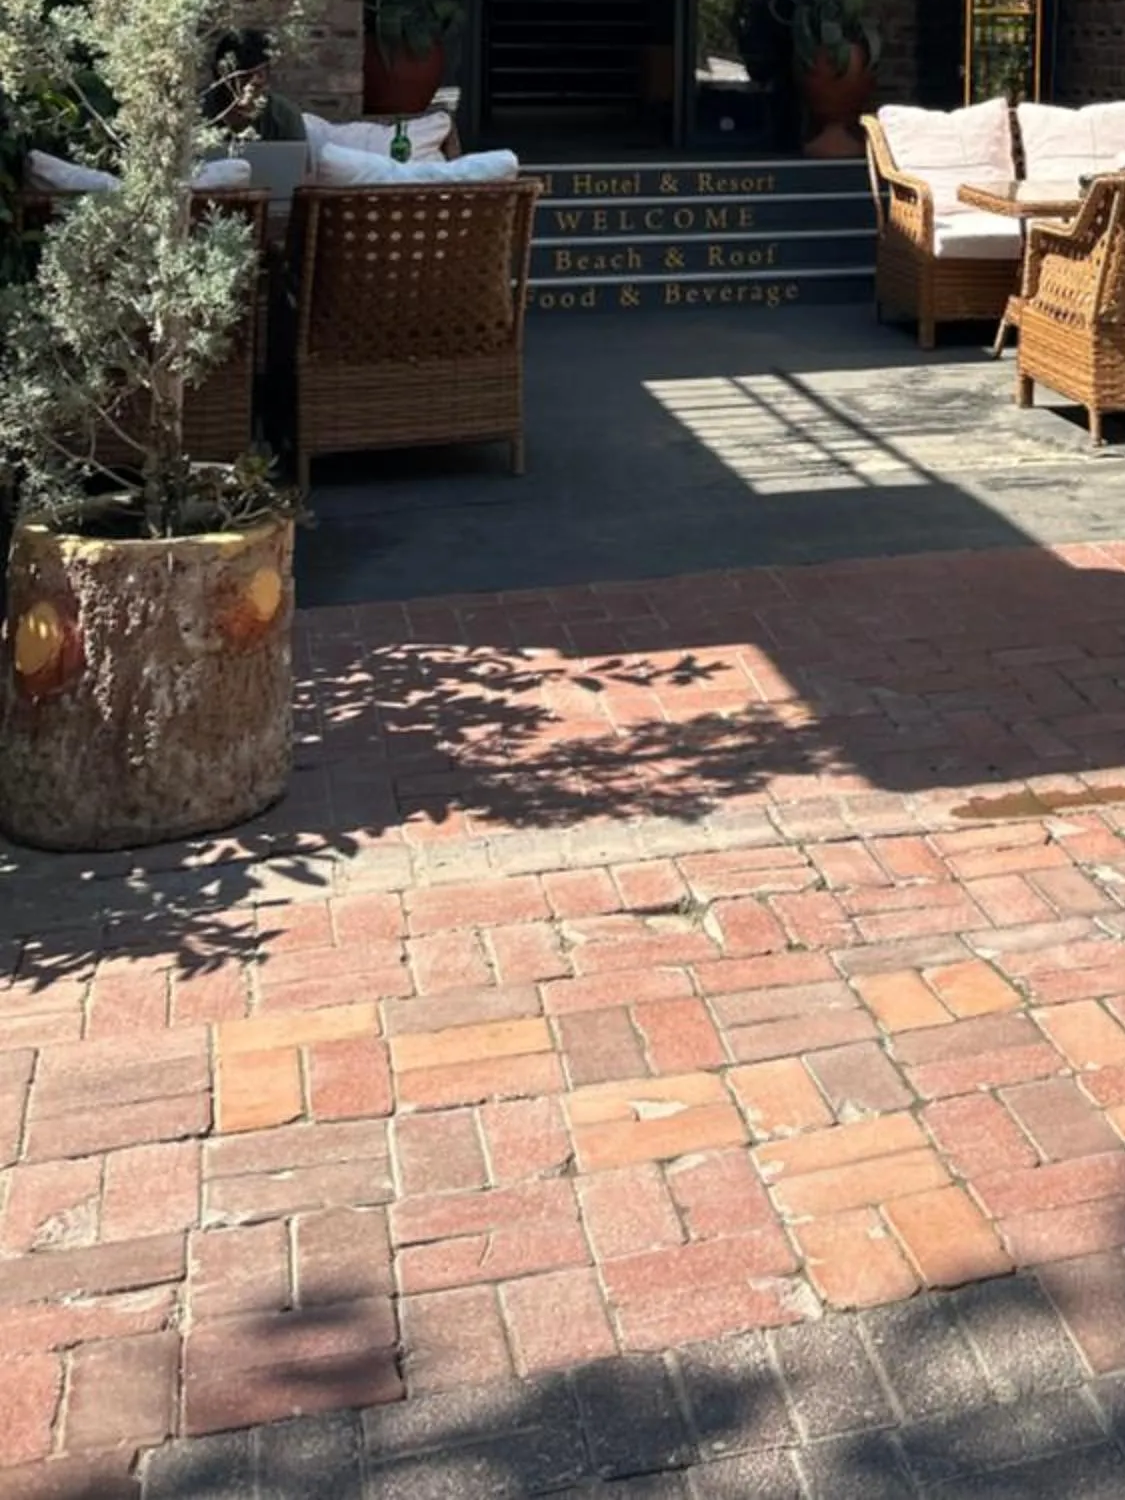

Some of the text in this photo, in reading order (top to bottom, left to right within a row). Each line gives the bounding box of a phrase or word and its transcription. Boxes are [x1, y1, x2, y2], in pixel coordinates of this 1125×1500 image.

[573, 174, 641, 194] Hotel
[659, 173, 679, 193] &
[699, 172, 776, 193] Resort
[556, 208, 755, 231] WELCOME
[555, 244, 776, 271] Beach & Roof
[619, 284, 640, 307] &
[665, 282, 798, 307] Beverage
